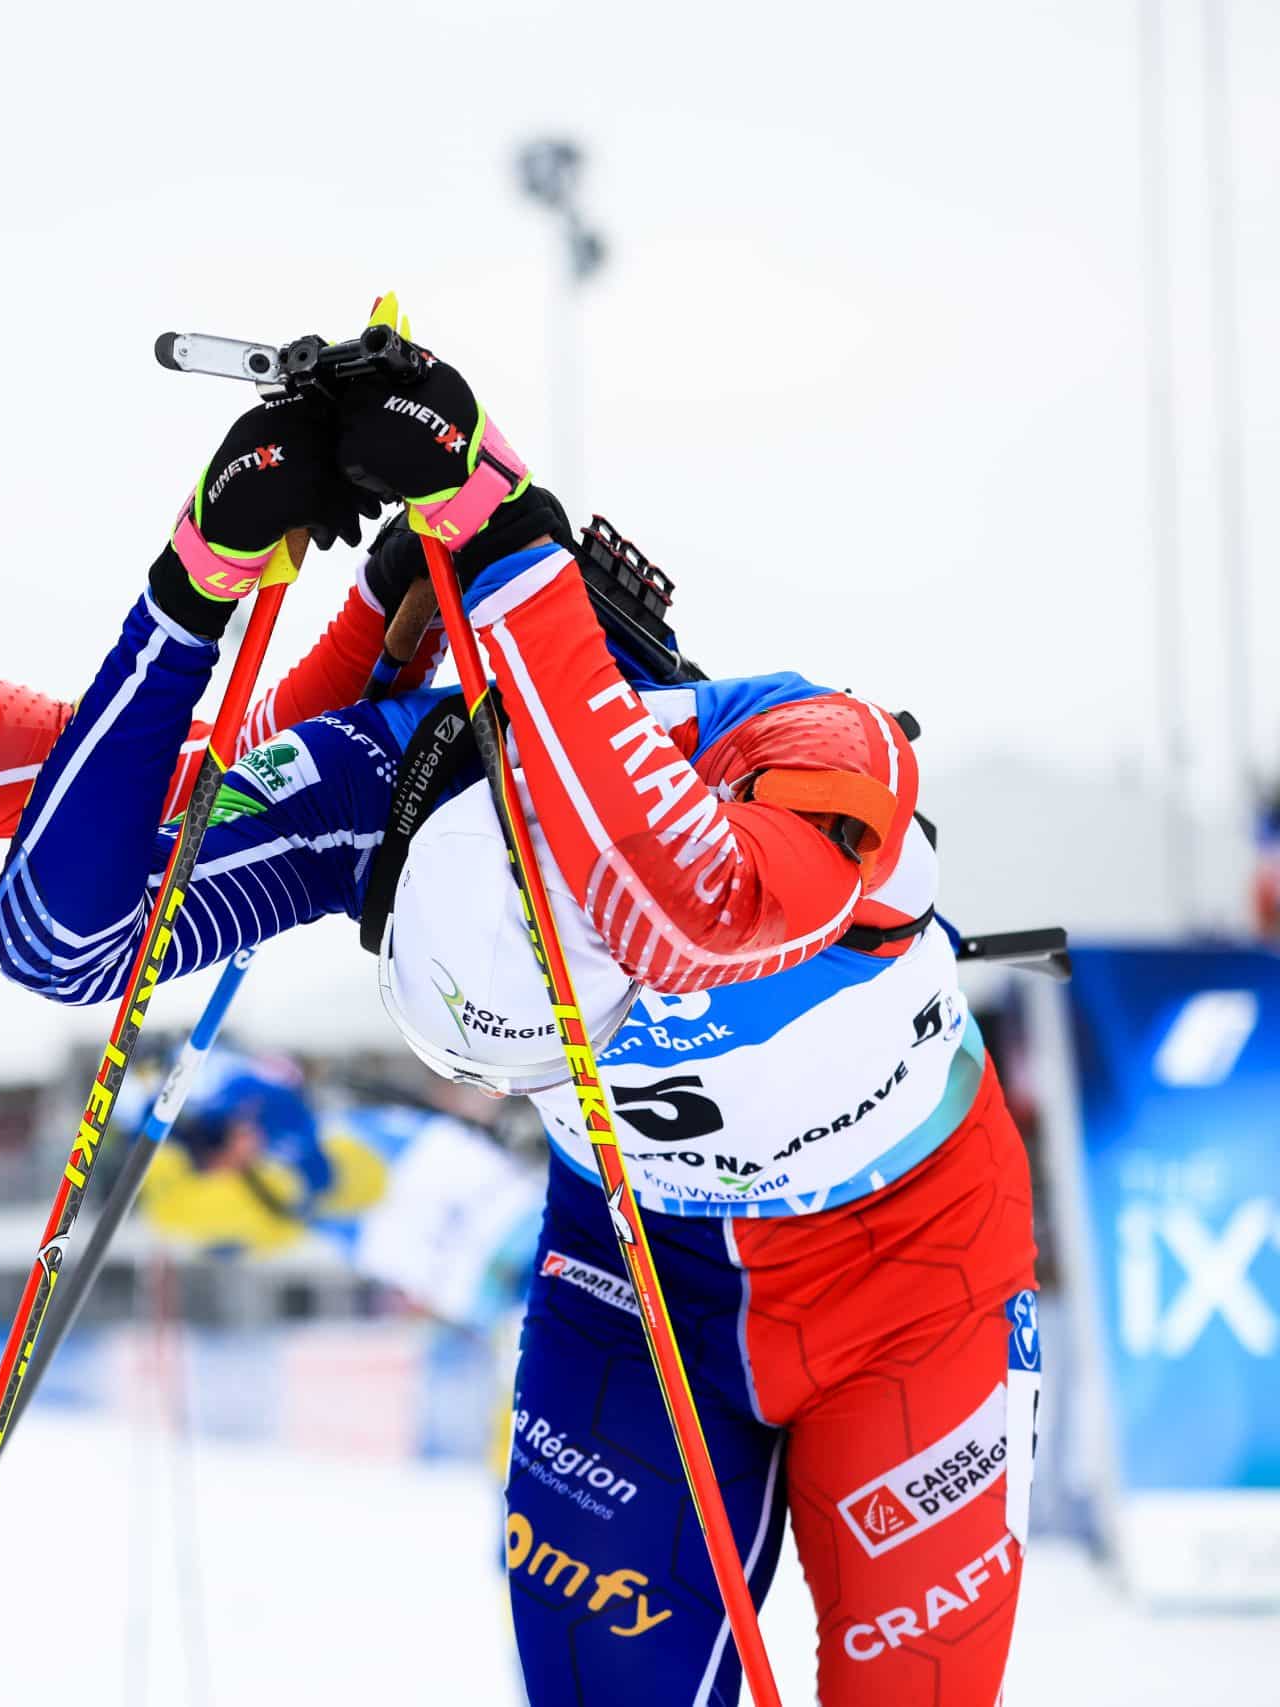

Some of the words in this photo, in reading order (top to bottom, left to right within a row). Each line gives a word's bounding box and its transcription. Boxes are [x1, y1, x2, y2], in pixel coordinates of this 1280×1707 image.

[462, 1013, 556, 1039] ENERGIE
[464, 1000, 509, 1025] ROY
[647, 1021, 736, 1052] Bank
[552, 1004, 618, 1146] LEKI
[610, 1074, 724, 1142] 5
[64, 1041, 127, 1190] LEKI
[714, 1154, 764, 1176] NA
[772, 1060, 909, 1161] MORAVE
[643, 1168, 683, 1198] Kraj
[525, 1417, 638, 1505] Région
[905, 1439, 985, 1500] CAISSE
[507, 1511, 673, 1637] omfy
[843, 1530, 1015, 1662] CRAFT
